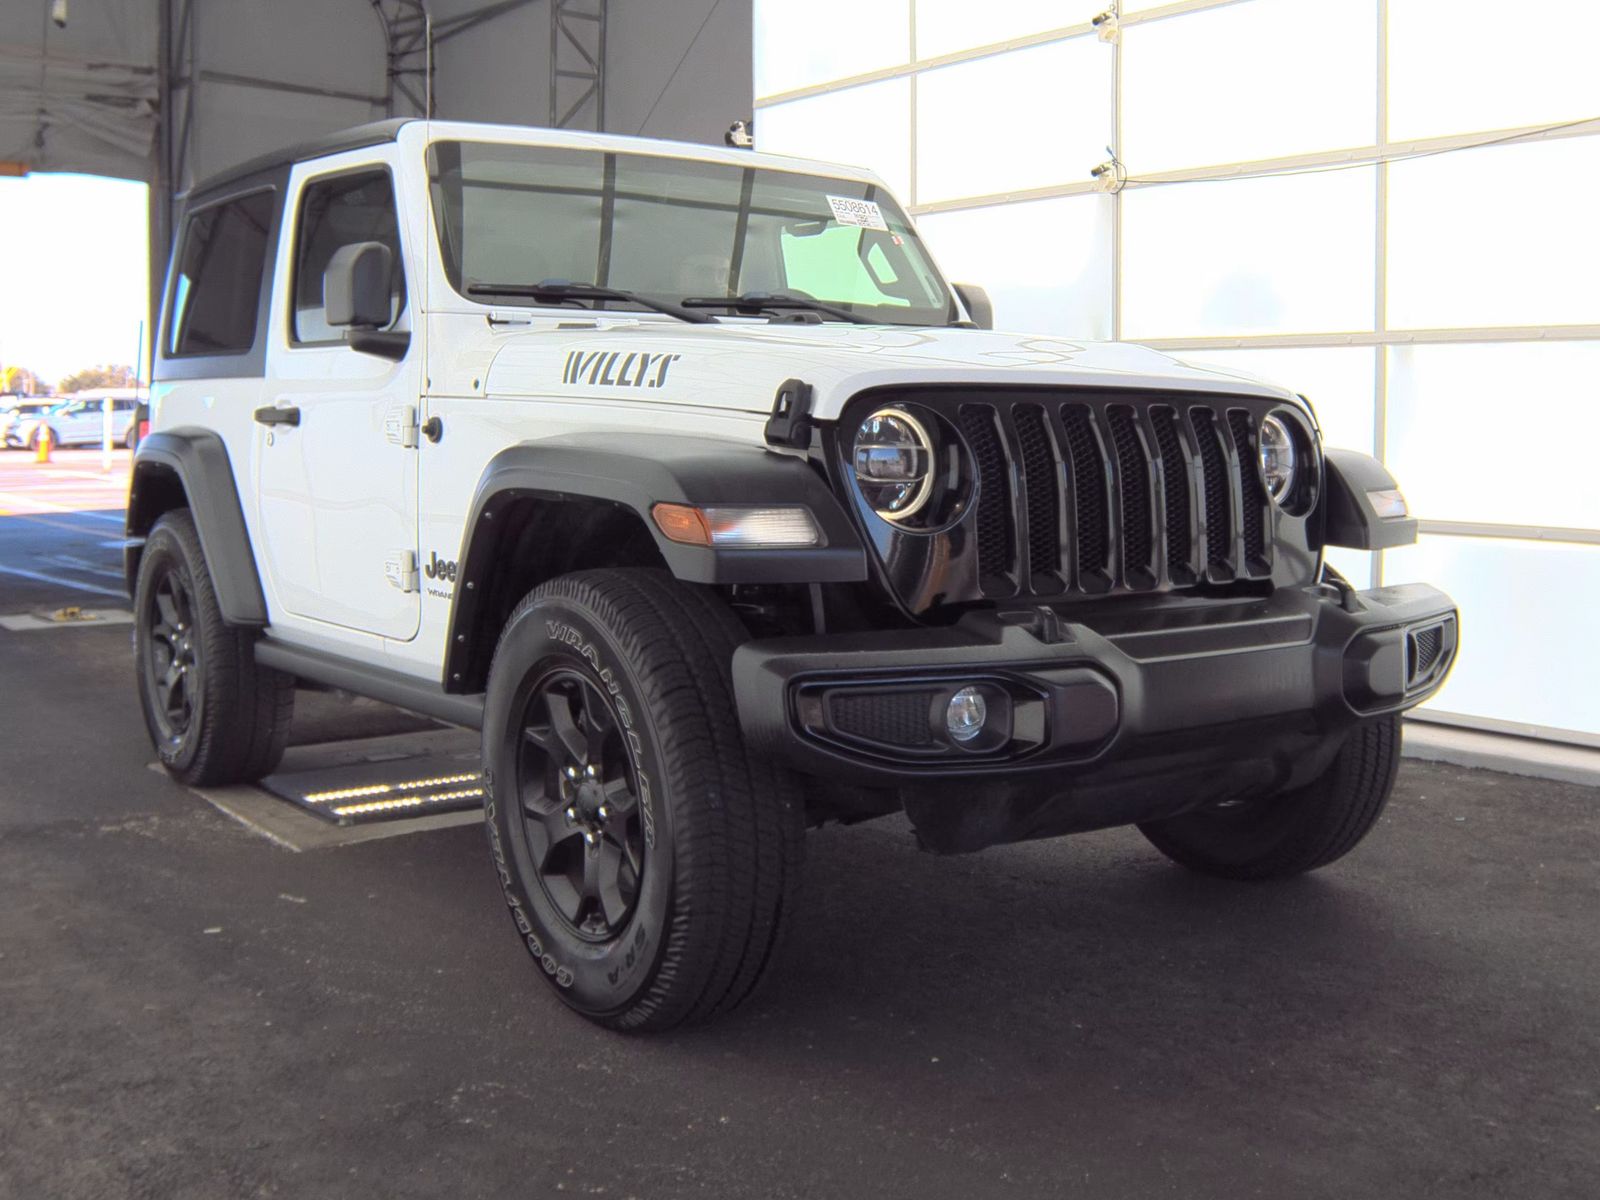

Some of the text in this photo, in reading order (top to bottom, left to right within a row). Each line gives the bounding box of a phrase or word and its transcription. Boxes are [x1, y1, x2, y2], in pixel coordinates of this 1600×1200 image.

[831, 199, 879, 216] 5508614
[562, 351, 681, 389] WILLYS
[425, 551, 458, 583] Jee
[546, 619, 655, 850] WRANGLER
